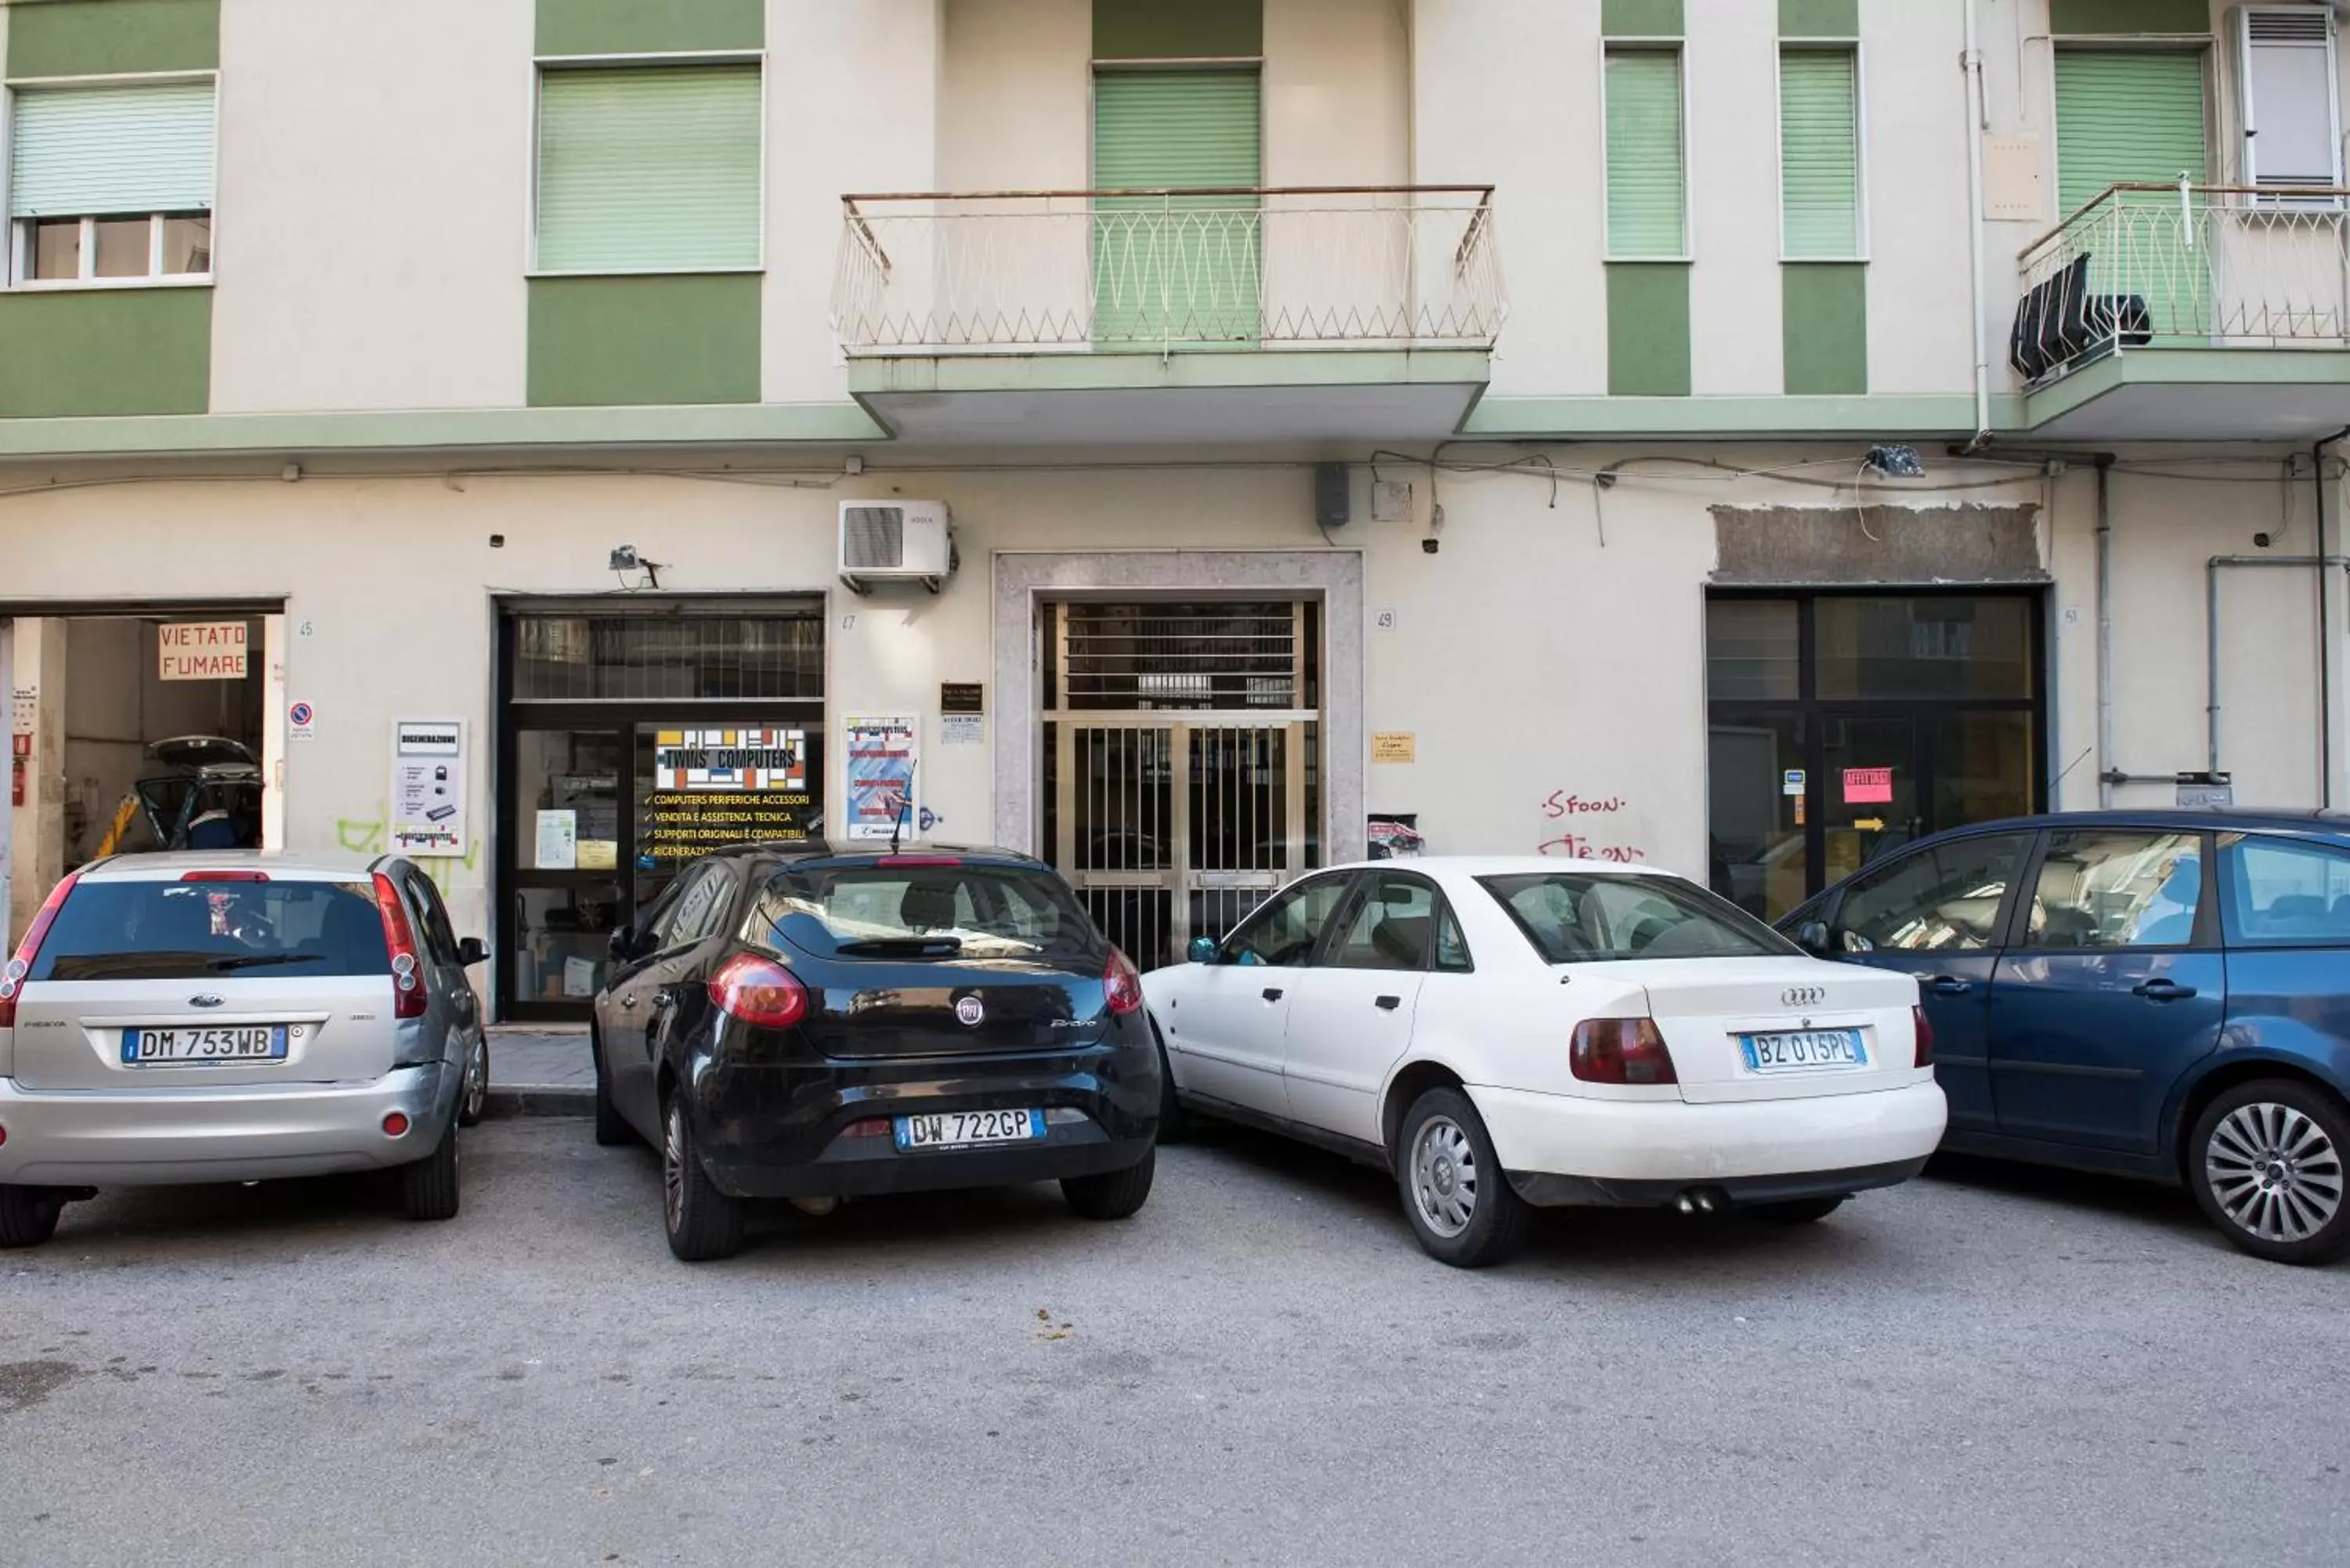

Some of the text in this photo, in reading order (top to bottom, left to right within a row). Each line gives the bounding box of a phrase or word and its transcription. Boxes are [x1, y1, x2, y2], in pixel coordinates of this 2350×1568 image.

[1378, 612, 1392, 627] 49
[161, 627, 246, 645] VIETATO
[163, 656, 245, 674] FUMARE
[718, 750, 796, 768] COMPUTERS
[654, 795, 809, 804] COMPUTERS PERIFERICHE ACCESSORI
[654, 812, 791, 822] VENDITA E ASSISTENZA TECNICA
[654, 829, 696, 839] SUPPORTI
[699, 829, 743, 839] ORIGINALI
[752, 829, 806, 839] COMPATIBILI
[142, 1031, 175, 1056] DM
[186, 1029, 269, 1055] 753WB
[1758, 1032, 1854, 1063] BZ 015PL
[913, 1116, 942, 1143] DW
[952, 1111, 1028, 1140] 722GP
